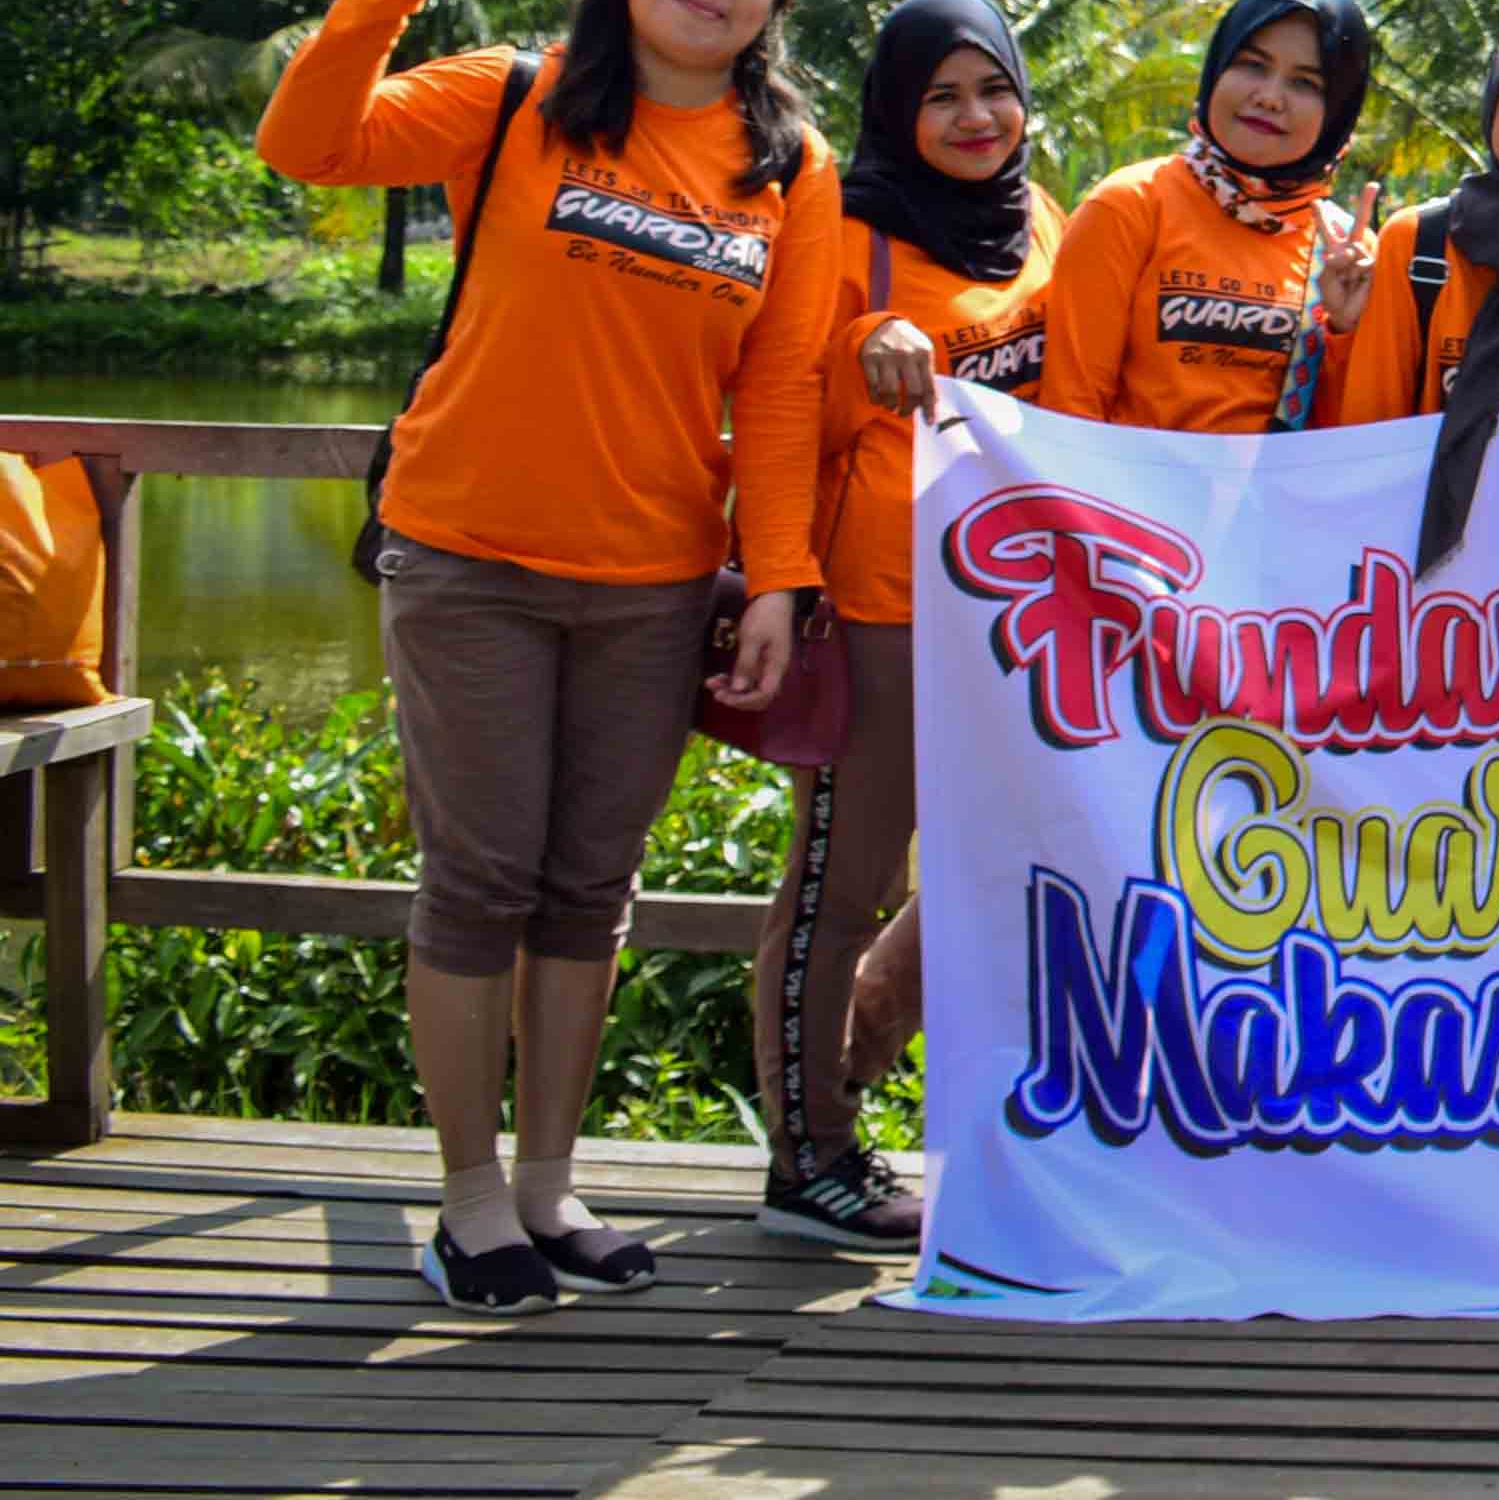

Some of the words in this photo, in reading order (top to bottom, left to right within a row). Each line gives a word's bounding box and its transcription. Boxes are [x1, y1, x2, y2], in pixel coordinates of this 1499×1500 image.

[562, 156, 618, 187] LETS
[555, 188, 769, 276] GUARDIAN
[1158, 269, 1207, 288] LETS
[1218, 276, 1242, 293] GO
[1255, 281, 1276, 297] TO
[1160, 296, 1297, 336] GUARD
